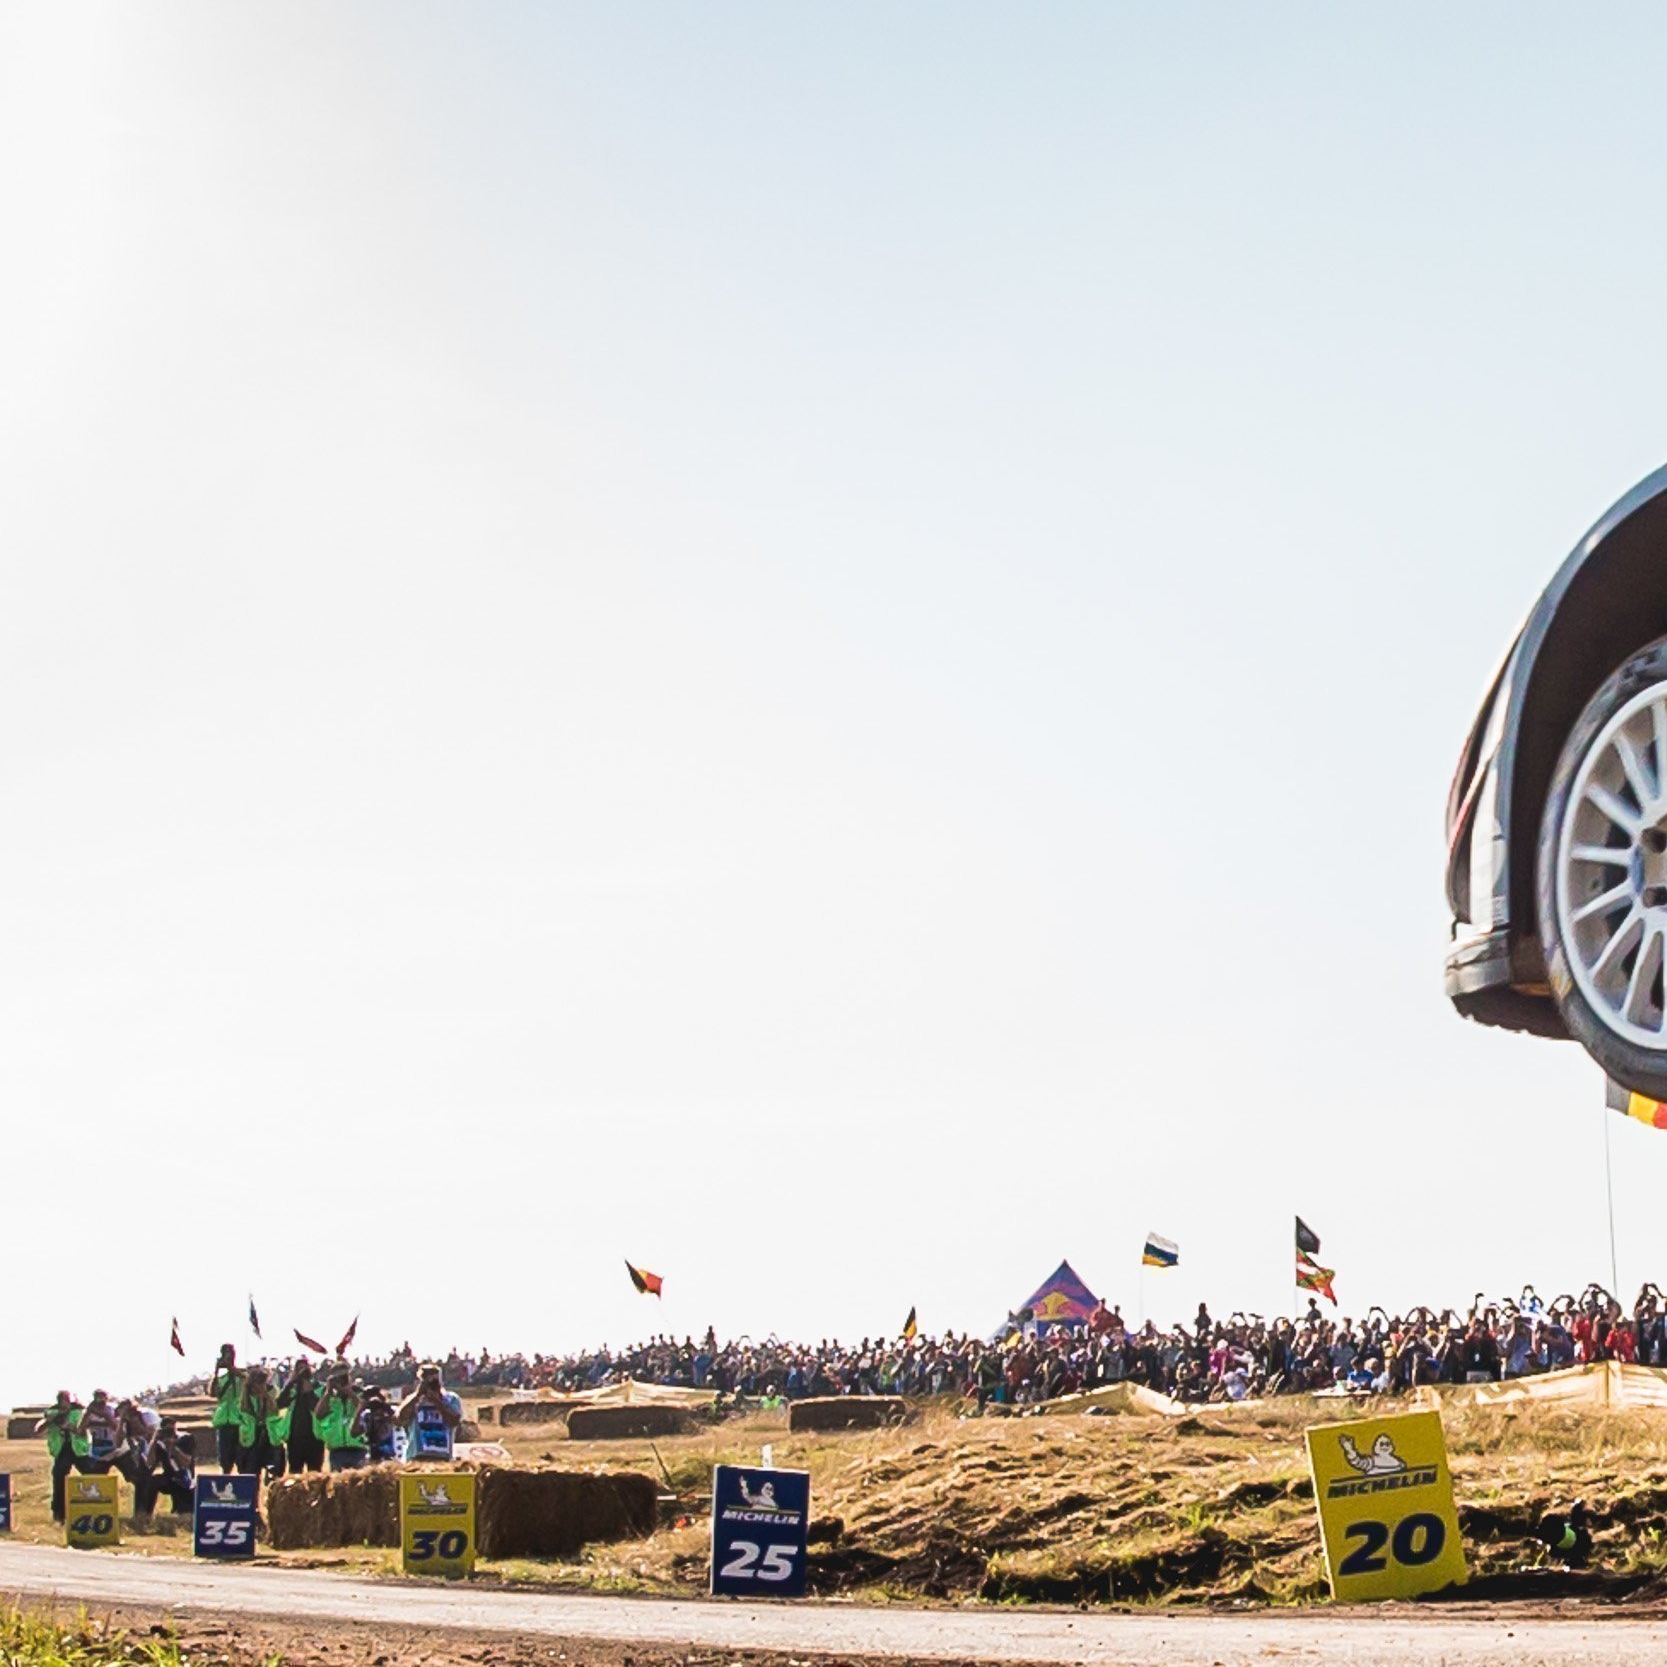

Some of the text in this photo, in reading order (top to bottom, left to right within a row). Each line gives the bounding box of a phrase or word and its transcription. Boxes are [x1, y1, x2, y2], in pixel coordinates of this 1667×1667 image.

[1326, 1468, 1439, 1500] MICHELIN
[71, 1514, 114, 1535] 40
[721, 1509, 800, 1525] MICHELIN
[199, 1521, 252, 1545] 35
[407, 1529, 469, 1560] 30
[1338, 1512, 1446, 1576] 20
[720, 1541, 799, 1581] 25
